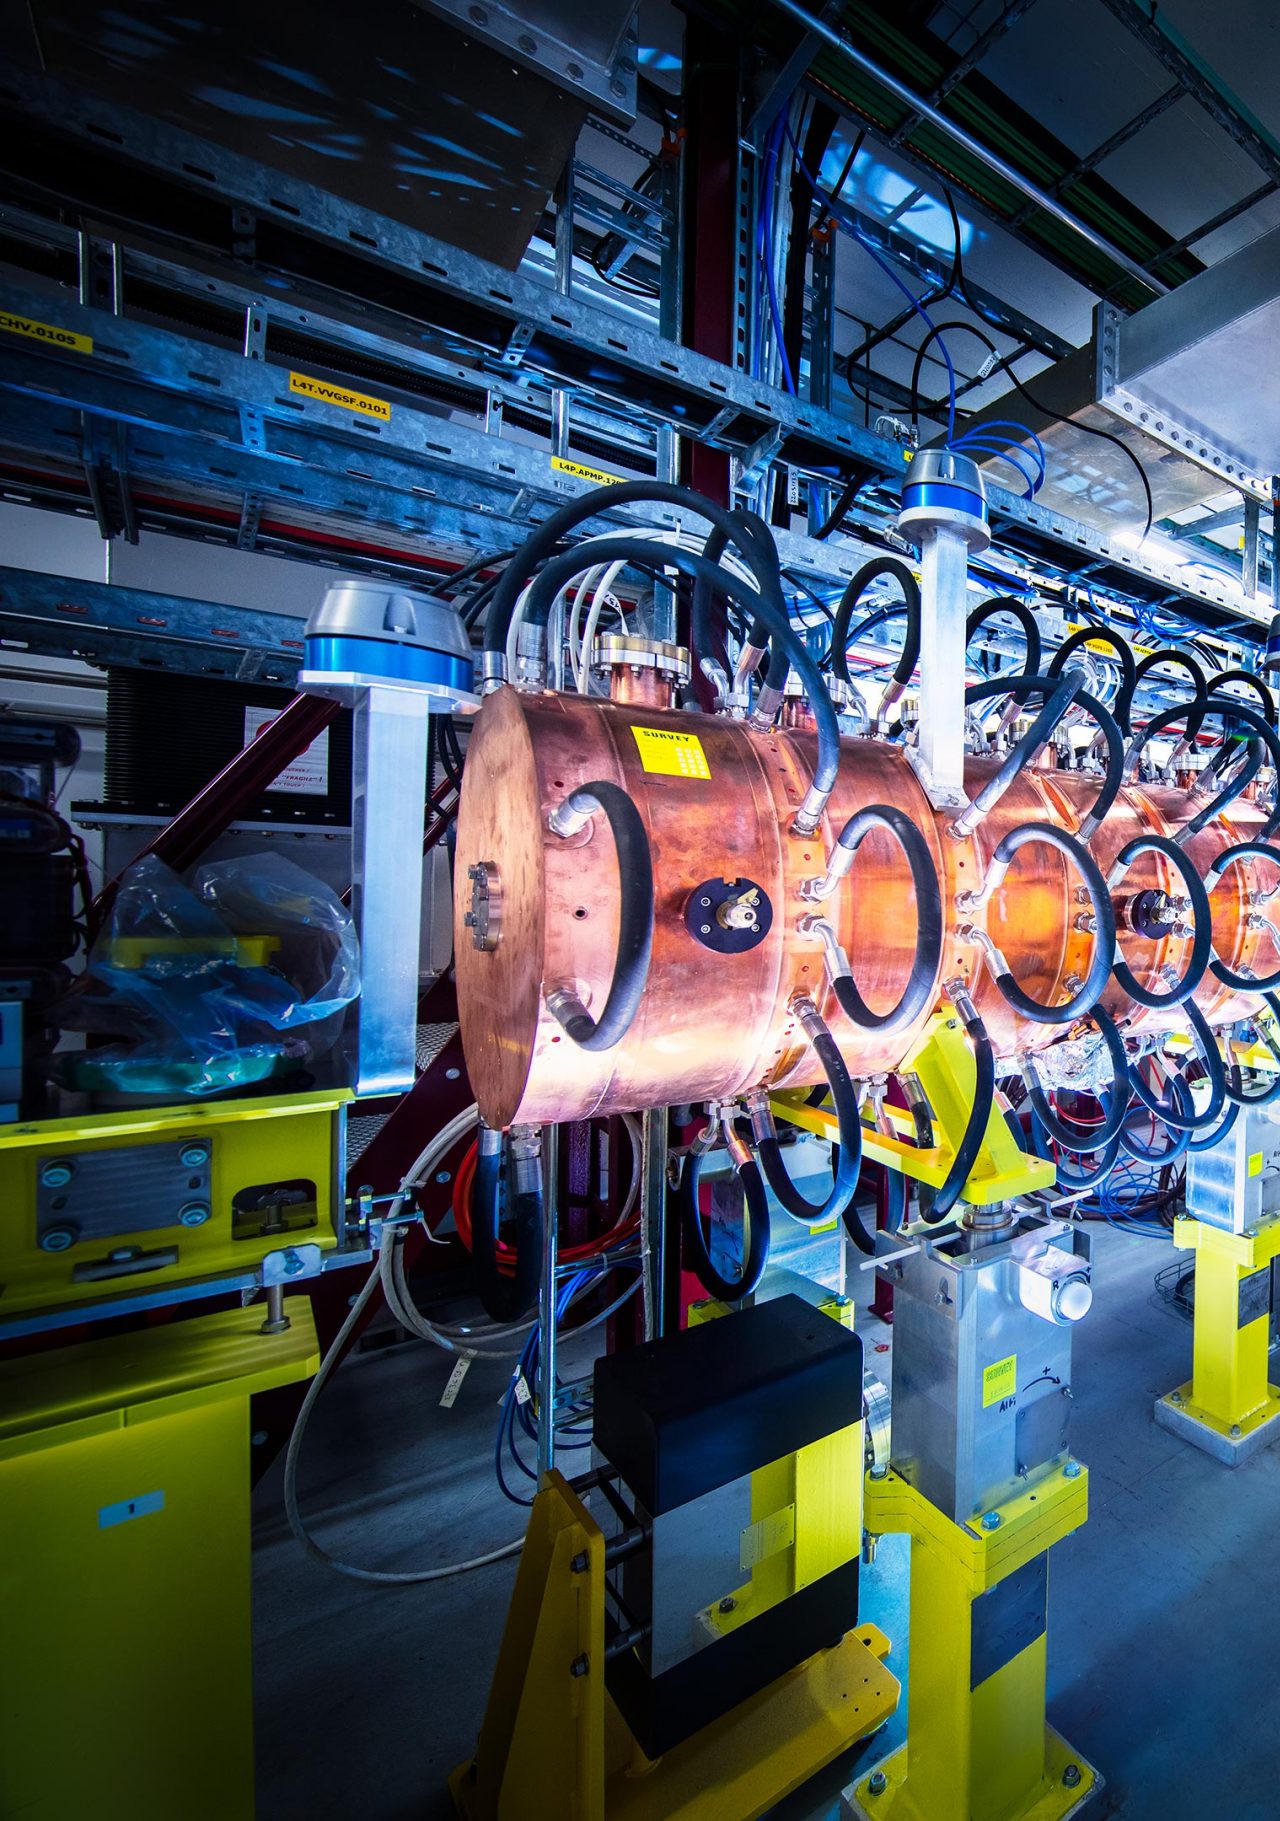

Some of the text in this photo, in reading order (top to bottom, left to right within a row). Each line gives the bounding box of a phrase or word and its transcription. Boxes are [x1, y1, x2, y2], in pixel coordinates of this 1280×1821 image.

[292, 378, 388, 415] L4T.VVGSF.0101
[643, 730, 690, 742] SURVEY
[1052, 1280, 1059, 1291] R
[127, 1503, 135, 1514] 1
